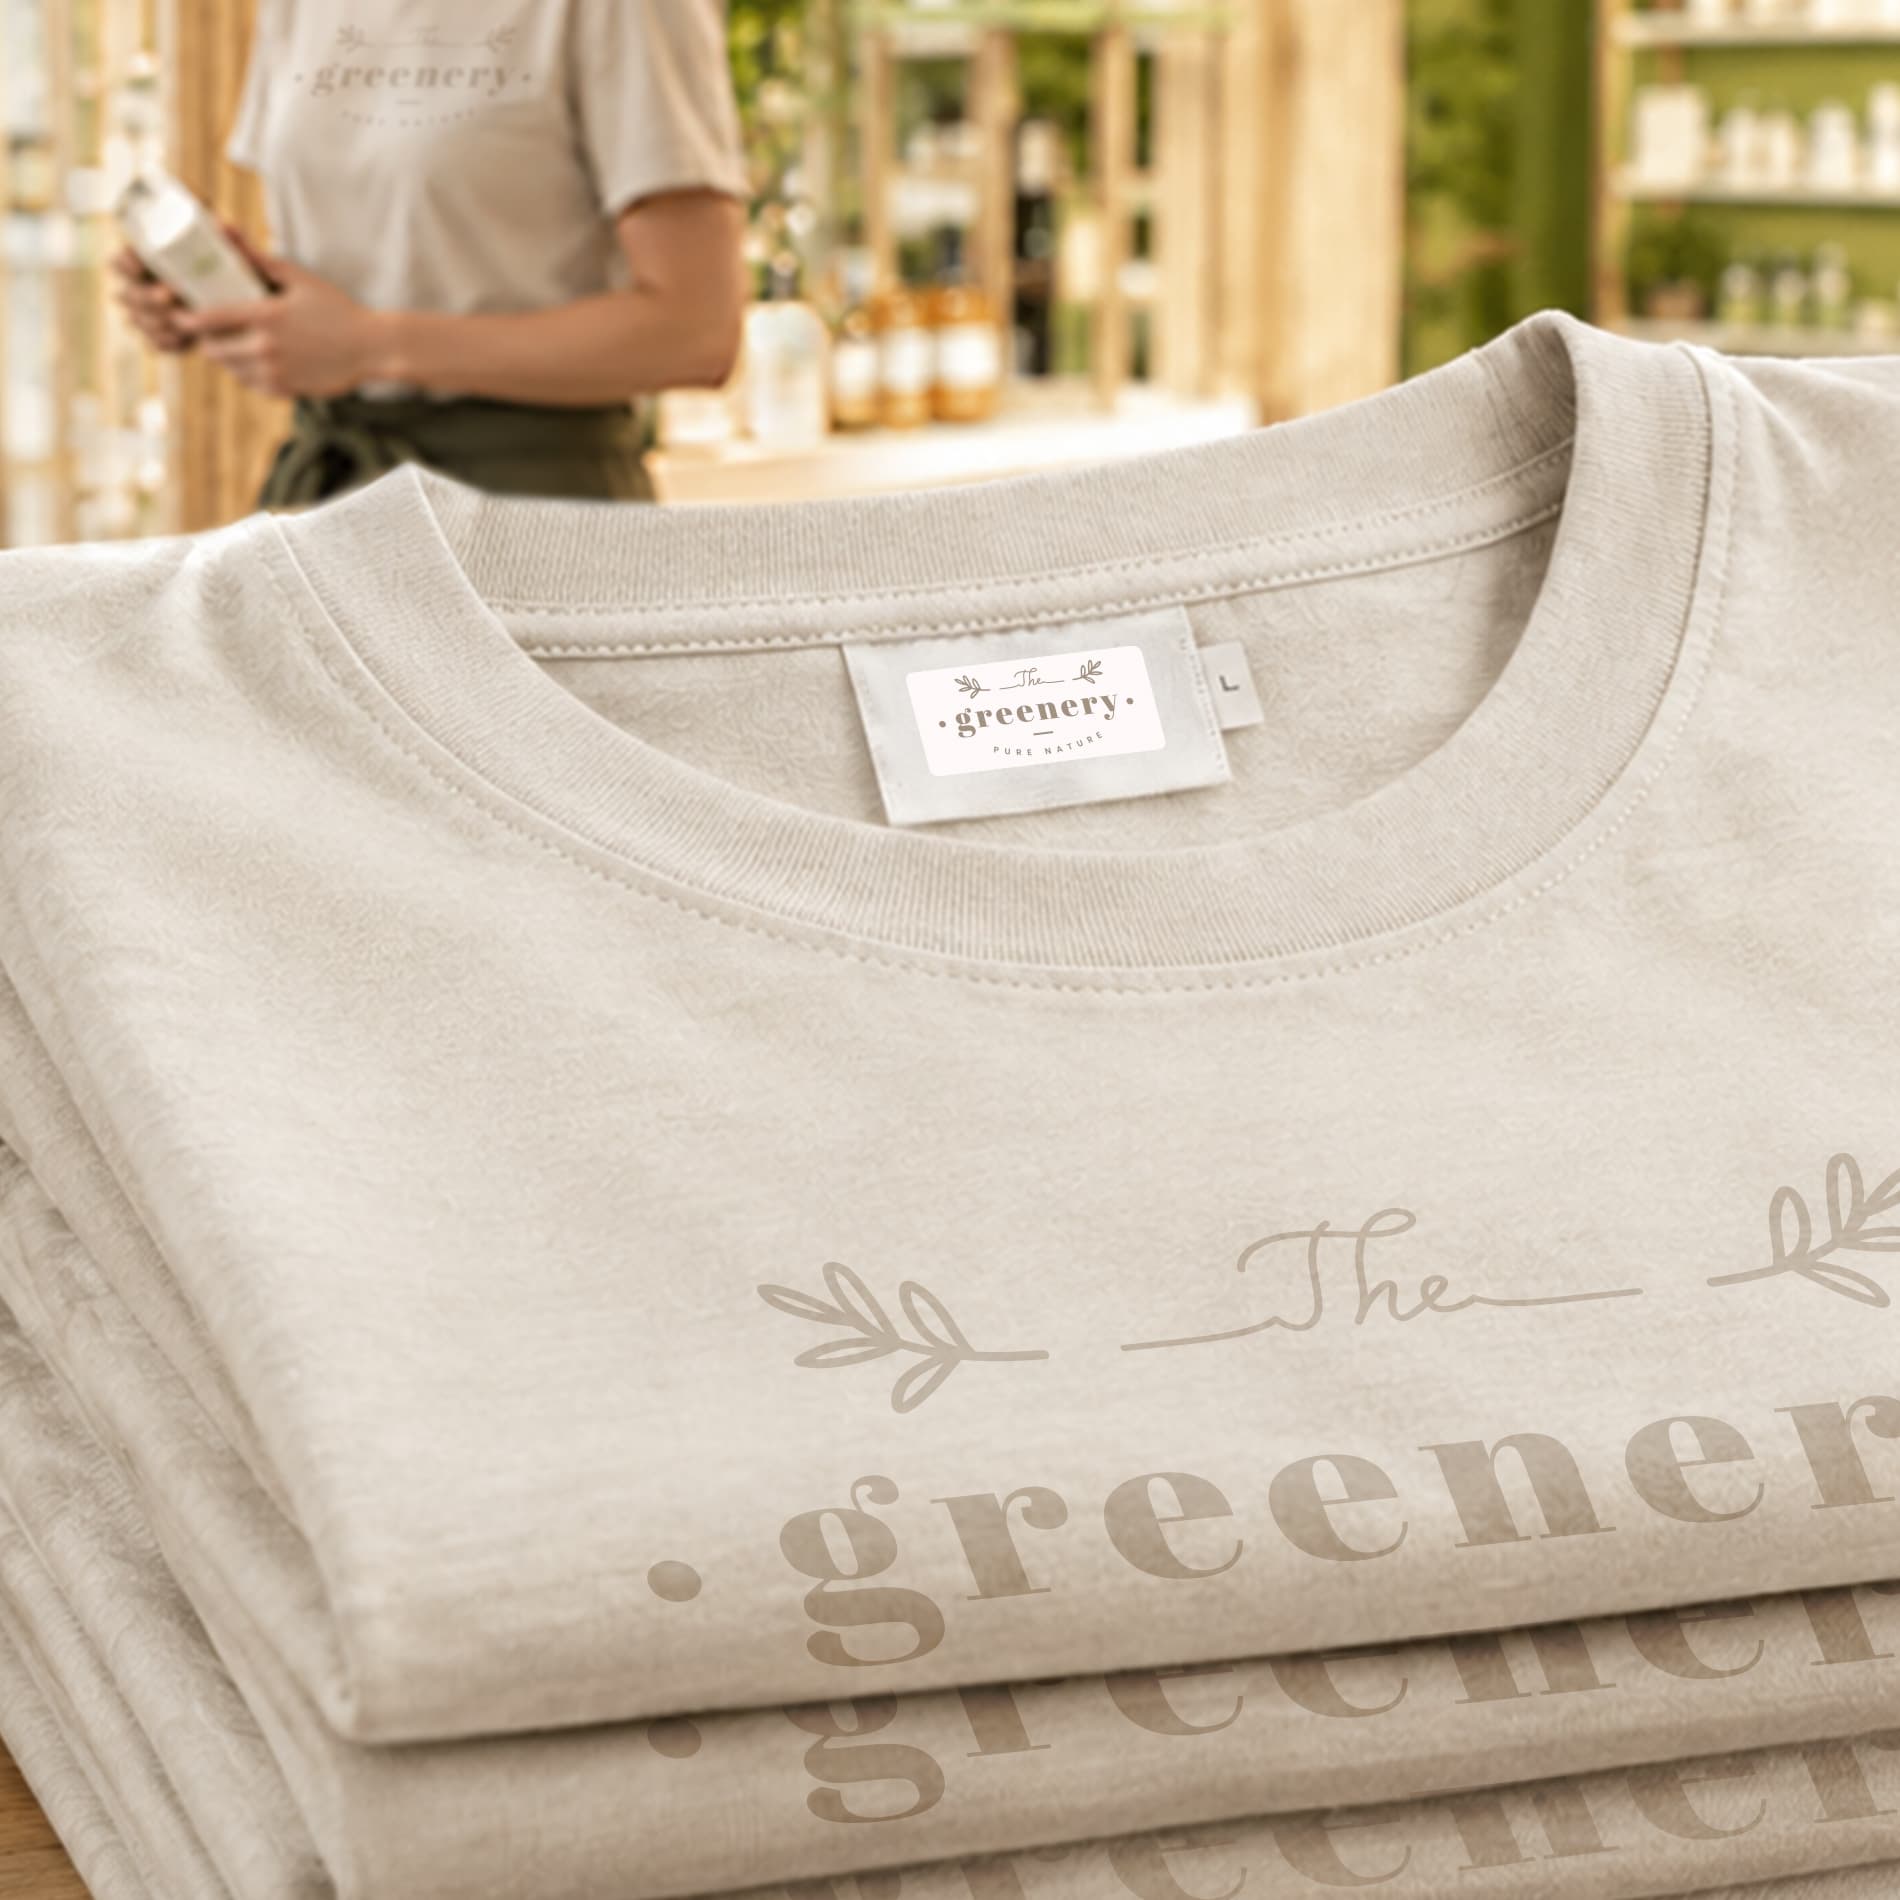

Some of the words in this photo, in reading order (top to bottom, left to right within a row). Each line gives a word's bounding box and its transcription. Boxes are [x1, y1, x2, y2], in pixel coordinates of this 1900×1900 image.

[310, 60, 516, 97] greenery
[1219, 674, 1240, 692] L
[955, 694, 1118, 738] greenery
[993, 745, 1033, 756] PURE
[1044, 731, 1103, 755] NATURE
